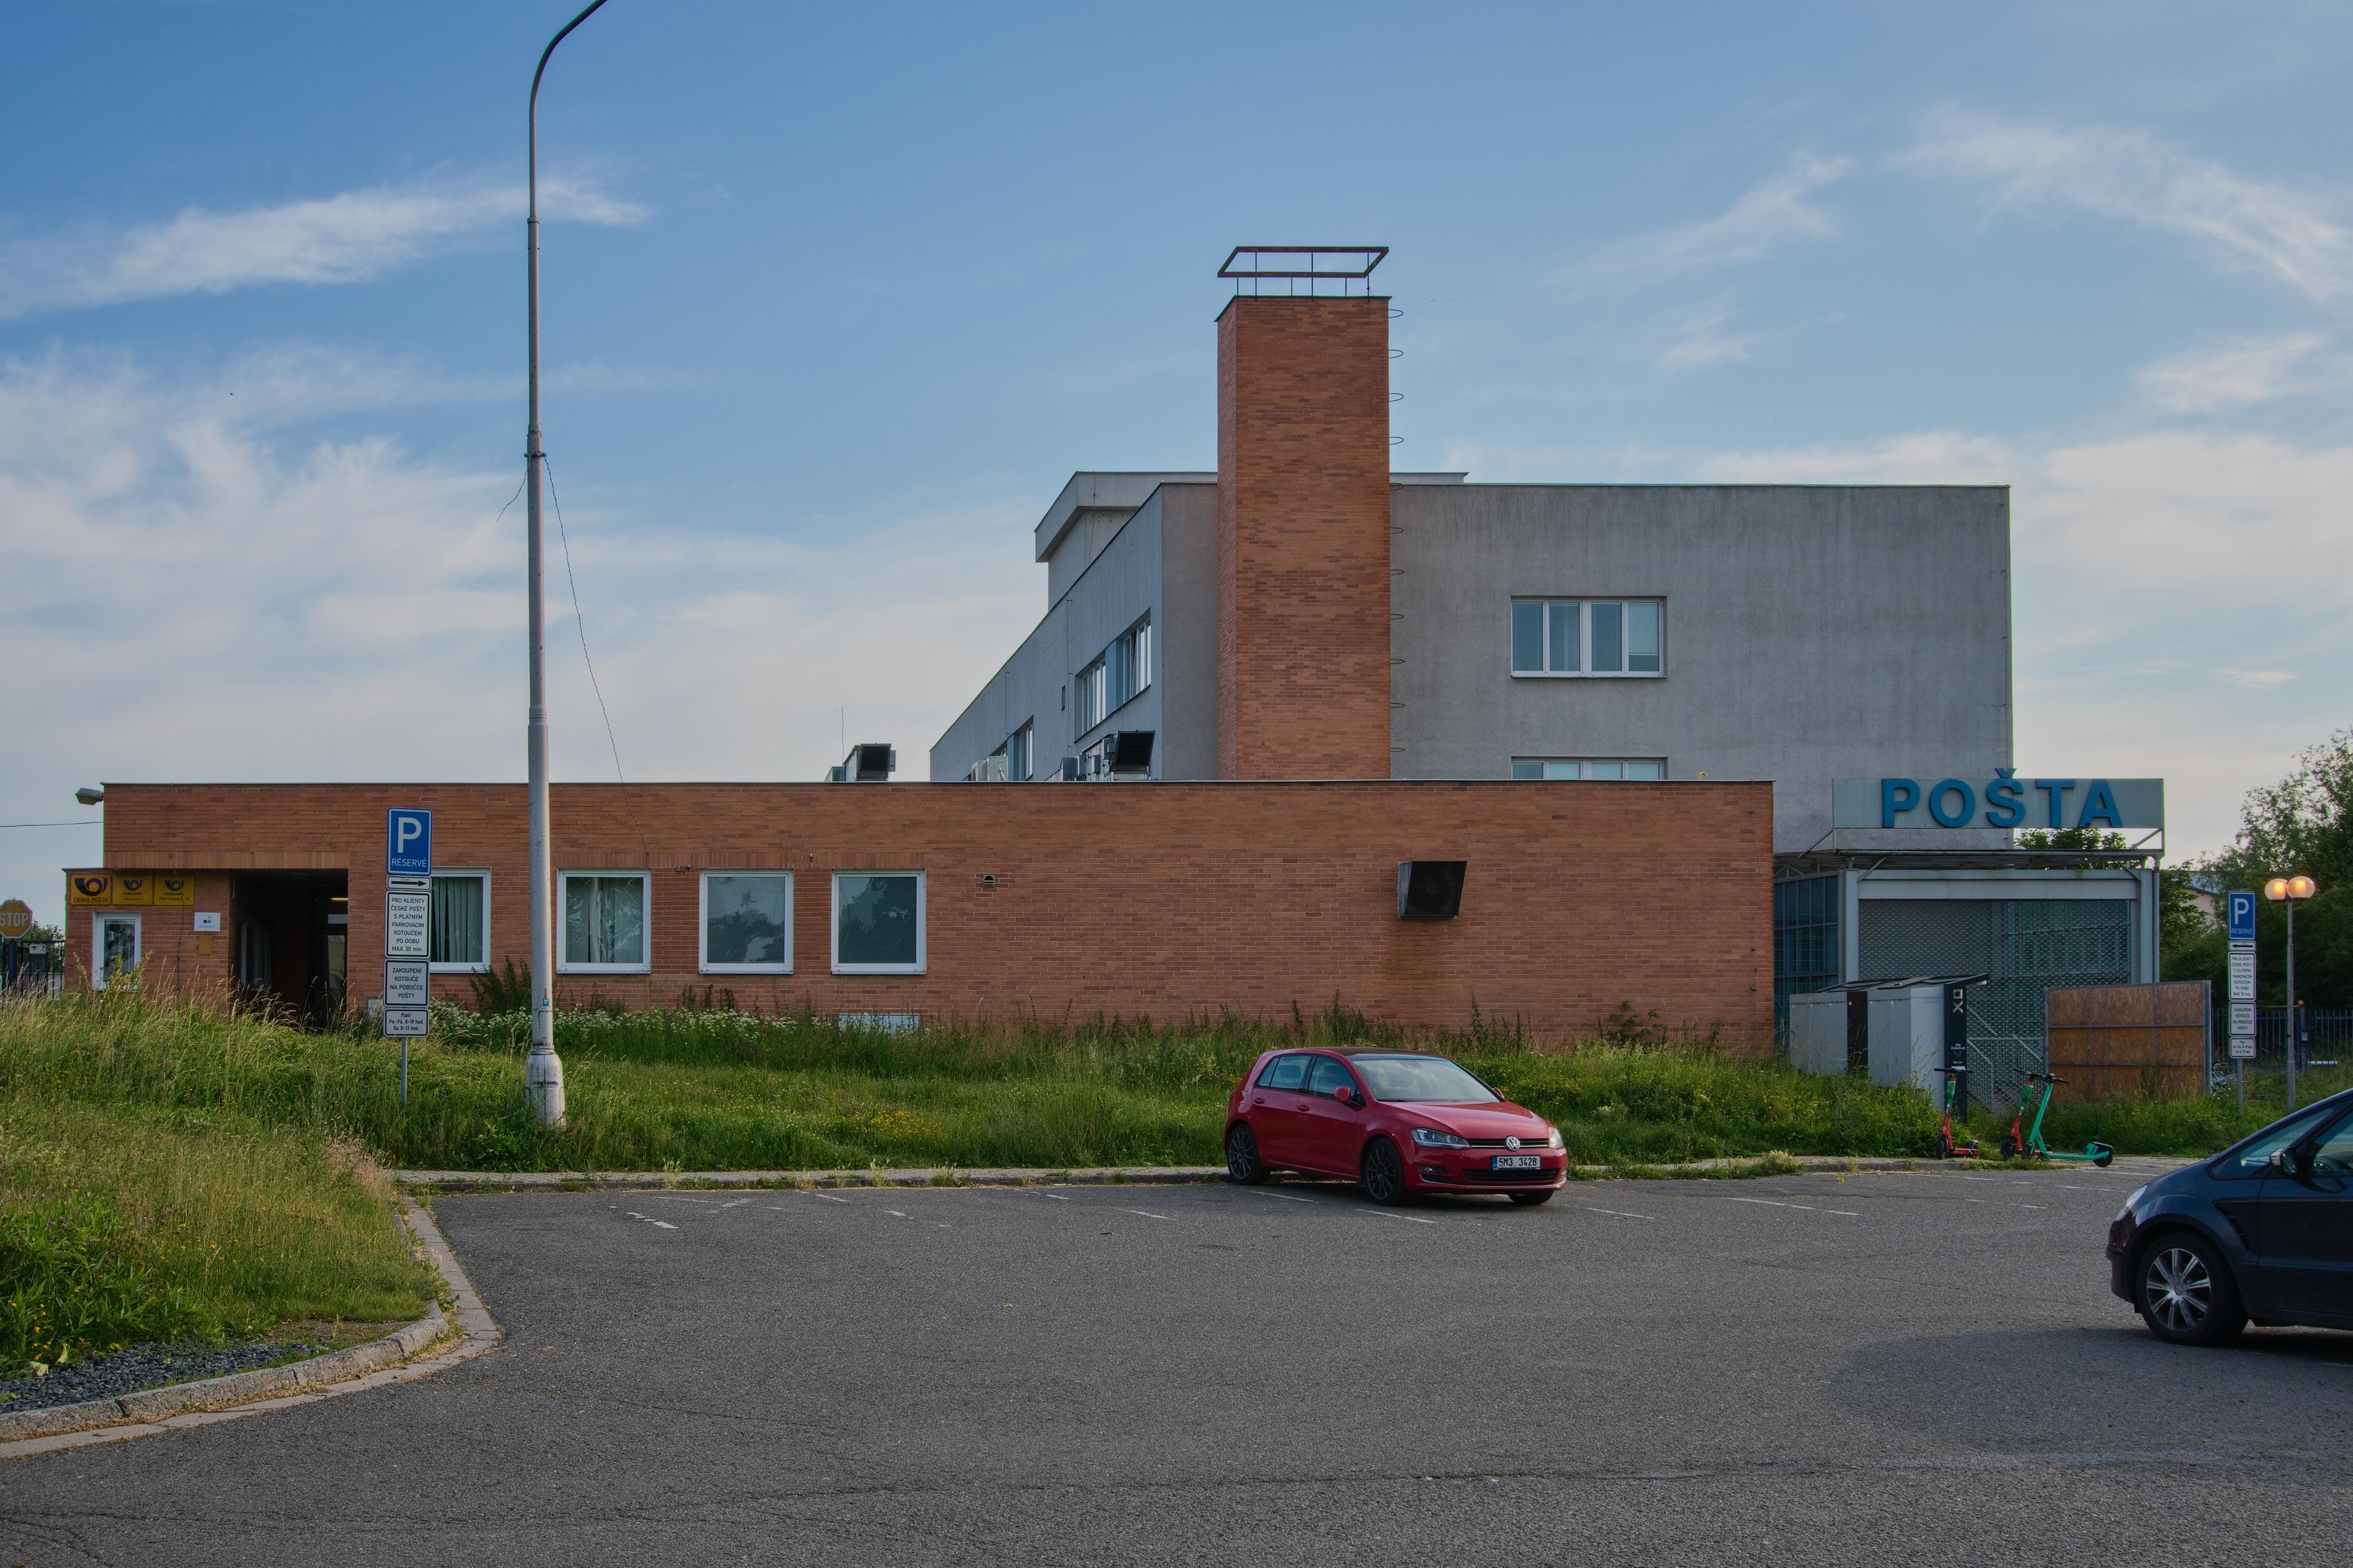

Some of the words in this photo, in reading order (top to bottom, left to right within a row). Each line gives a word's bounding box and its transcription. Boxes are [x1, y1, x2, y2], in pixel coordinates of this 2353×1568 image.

[1882, 768, 2124, 829] POŠTA
[398, 817, 422, 853] P
[391, 857, 426, 867] RÉSERVÉ
[0, 912, 29, 926] STOP
[2234, 898, 2249, 924] P
[1499, 1157, 1513, 1166] 5M3
[1519, 1157, 1537, 1166] 3428
